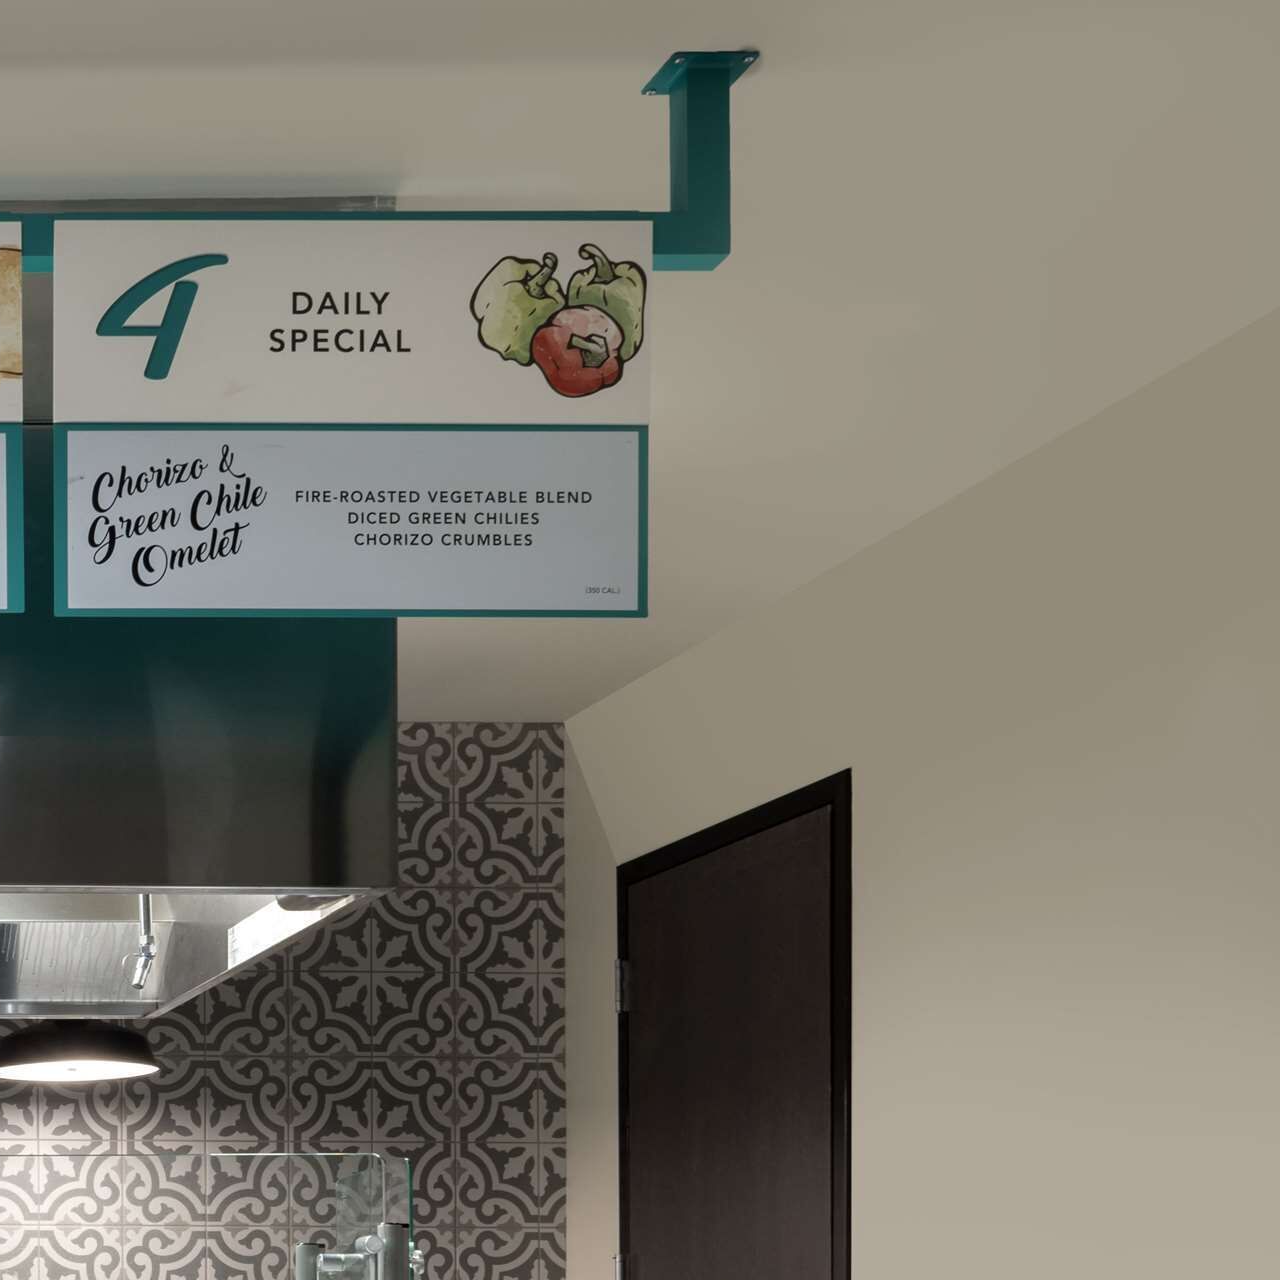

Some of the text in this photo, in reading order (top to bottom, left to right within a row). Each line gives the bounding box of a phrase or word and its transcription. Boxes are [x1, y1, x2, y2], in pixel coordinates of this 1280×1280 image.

[291, 291, 390, 316] DAILY
[96, 253, 229, 380] 4
[269, 328, 412, 353] SPECIAL
[91, 444, 247, 513] Chorizo &
[295, 490, 593, 504] FIRE-ROASTED VEGETABLE BLEND
[88, 477, 268, 565] Green Chile
[347, 511, 540, 526] DICED GREEN CHILIES
[353, 532, 533, 547] CHORIZO CRUMBLES
[131, 522, 251, 587] Omelet
